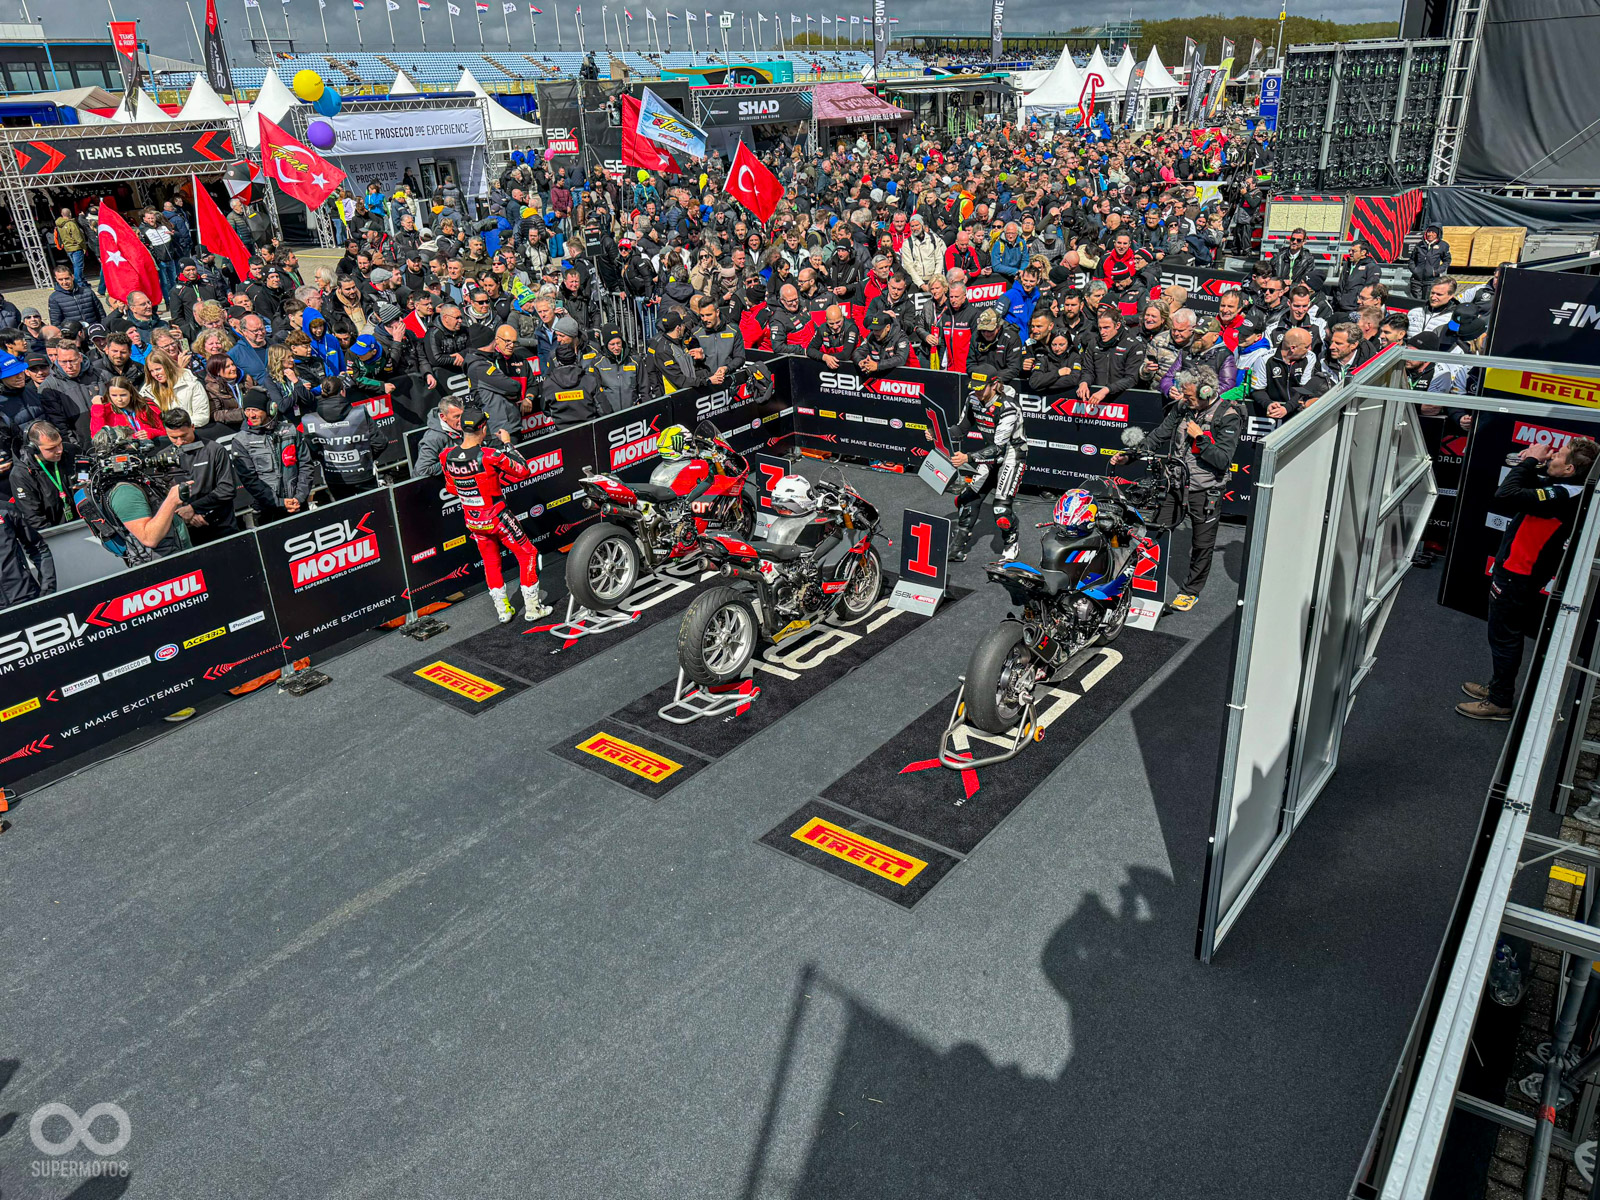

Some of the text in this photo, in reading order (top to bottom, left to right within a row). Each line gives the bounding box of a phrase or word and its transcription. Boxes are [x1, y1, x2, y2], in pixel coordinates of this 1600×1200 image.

[738, 100, 780, 115] SHAD
[336, 130, 358, 142] HARE
[358, 129, 374, 140] THE
[375, 126, 413, 139] PROSECCO
[427, 122, 470, 136] EXPERIENCE
[546, 128, 577, 139] SBK
[76, 143, 183, 160] TEAMS & RIDERS
[550, 141, 577, 151] MOTUL
[350, 161, 398, 174] BE PART OF THE
[356, 173, 388, 184] PROSECCO
[966, 285, 1004, 300] MOTUL
[1520, 371, 1600, 402] PIRELL
[832, 388, 860, 397] SUPERBIKE
[882, 394, 921, 404] CHAMPIONSHI
[706, 407, 729, 419] SUPERBIKE
[730, 401, 745, 410] WORLD
[1072, 402, 1126, 419] MOTUL
[1023, 411, 1128, 429] ERBIKE WORLD CHAMPIONSHIP
[312, 434, 368, 446] CONTROL
[608, 414, 661, 449] SBK
[868, 442, 907, 452] EXCITEMENT
[328, 452, 354, 461] 0136
[528, 453, 560, 473] OTUL
[1438, 455, 1462, 464] ORLD
[502, 467, 564, 495] ORLD CHAMPIONSHIP
[1052, 469, 1100, 480] EXCITEMENT
[442, 506, 455, 516] FIM
[284, 512, 375, 562] SBK
[413, 549, 436, 561] MOTUL
[908, 522, 938, 577] 1
[297, 539, 375, 583] MOTUL
[760, 561, 773, 574] 24
[305, 577, 330, 591] SUPERBIKE
[331, 570, 347, 581] WORLD
[348, 558, 381, 574] CHAMPIONSHIP
[122, 575, 202, 617] MOTUL
[295, 595, 396, 642] WE MAKE EXCITEMENT
[18, 637, 84, 668] SUPERBIKE
[88, 623, 128, 641] WORLD
[132, 592, 209, 626] CHAMPIONSHIP
[185, 628, 225, 648] ACERBIS
[114, 660, 141, 676] PROSECCO
[74, 677, 97, 688] TISSOT
[424, 665, 494, 698] PIRELLI
[2, 700, 38, 718] PIRELLI
[60, 678, 195, 739] WE MAKE EXCITEMENT
[587, 738, 671, 778] PIRELLI
[804, 824, 914, 879] PIRELLI
